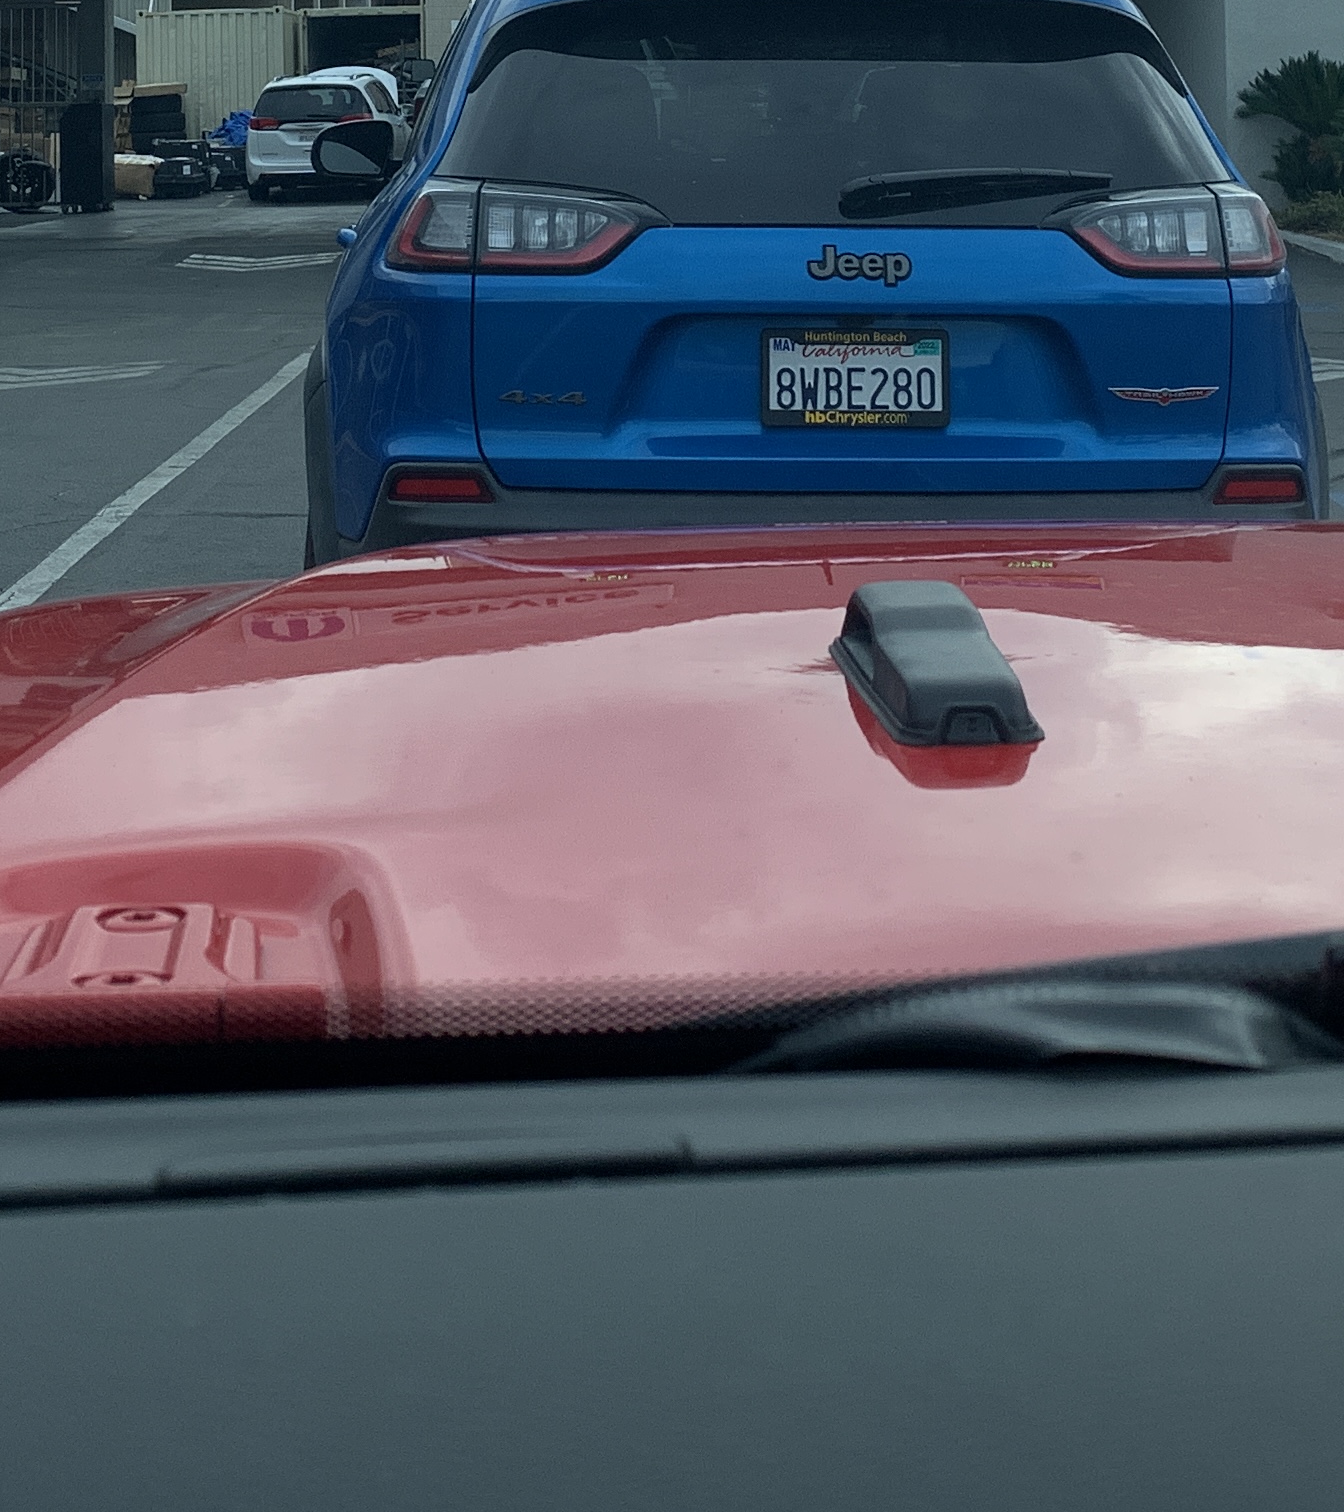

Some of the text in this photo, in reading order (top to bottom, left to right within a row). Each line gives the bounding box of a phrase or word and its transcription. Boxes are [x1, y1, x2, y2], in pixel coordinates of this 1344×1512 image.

[807, 244, 913, 288] Jeep
[805, 331, 907, 343] Huntington Beach
[773, 339, 797, 352] MAY
[776, 367, 936, 410] 8WBE280
[805, 411, 908, 426] hbChrysler.com
